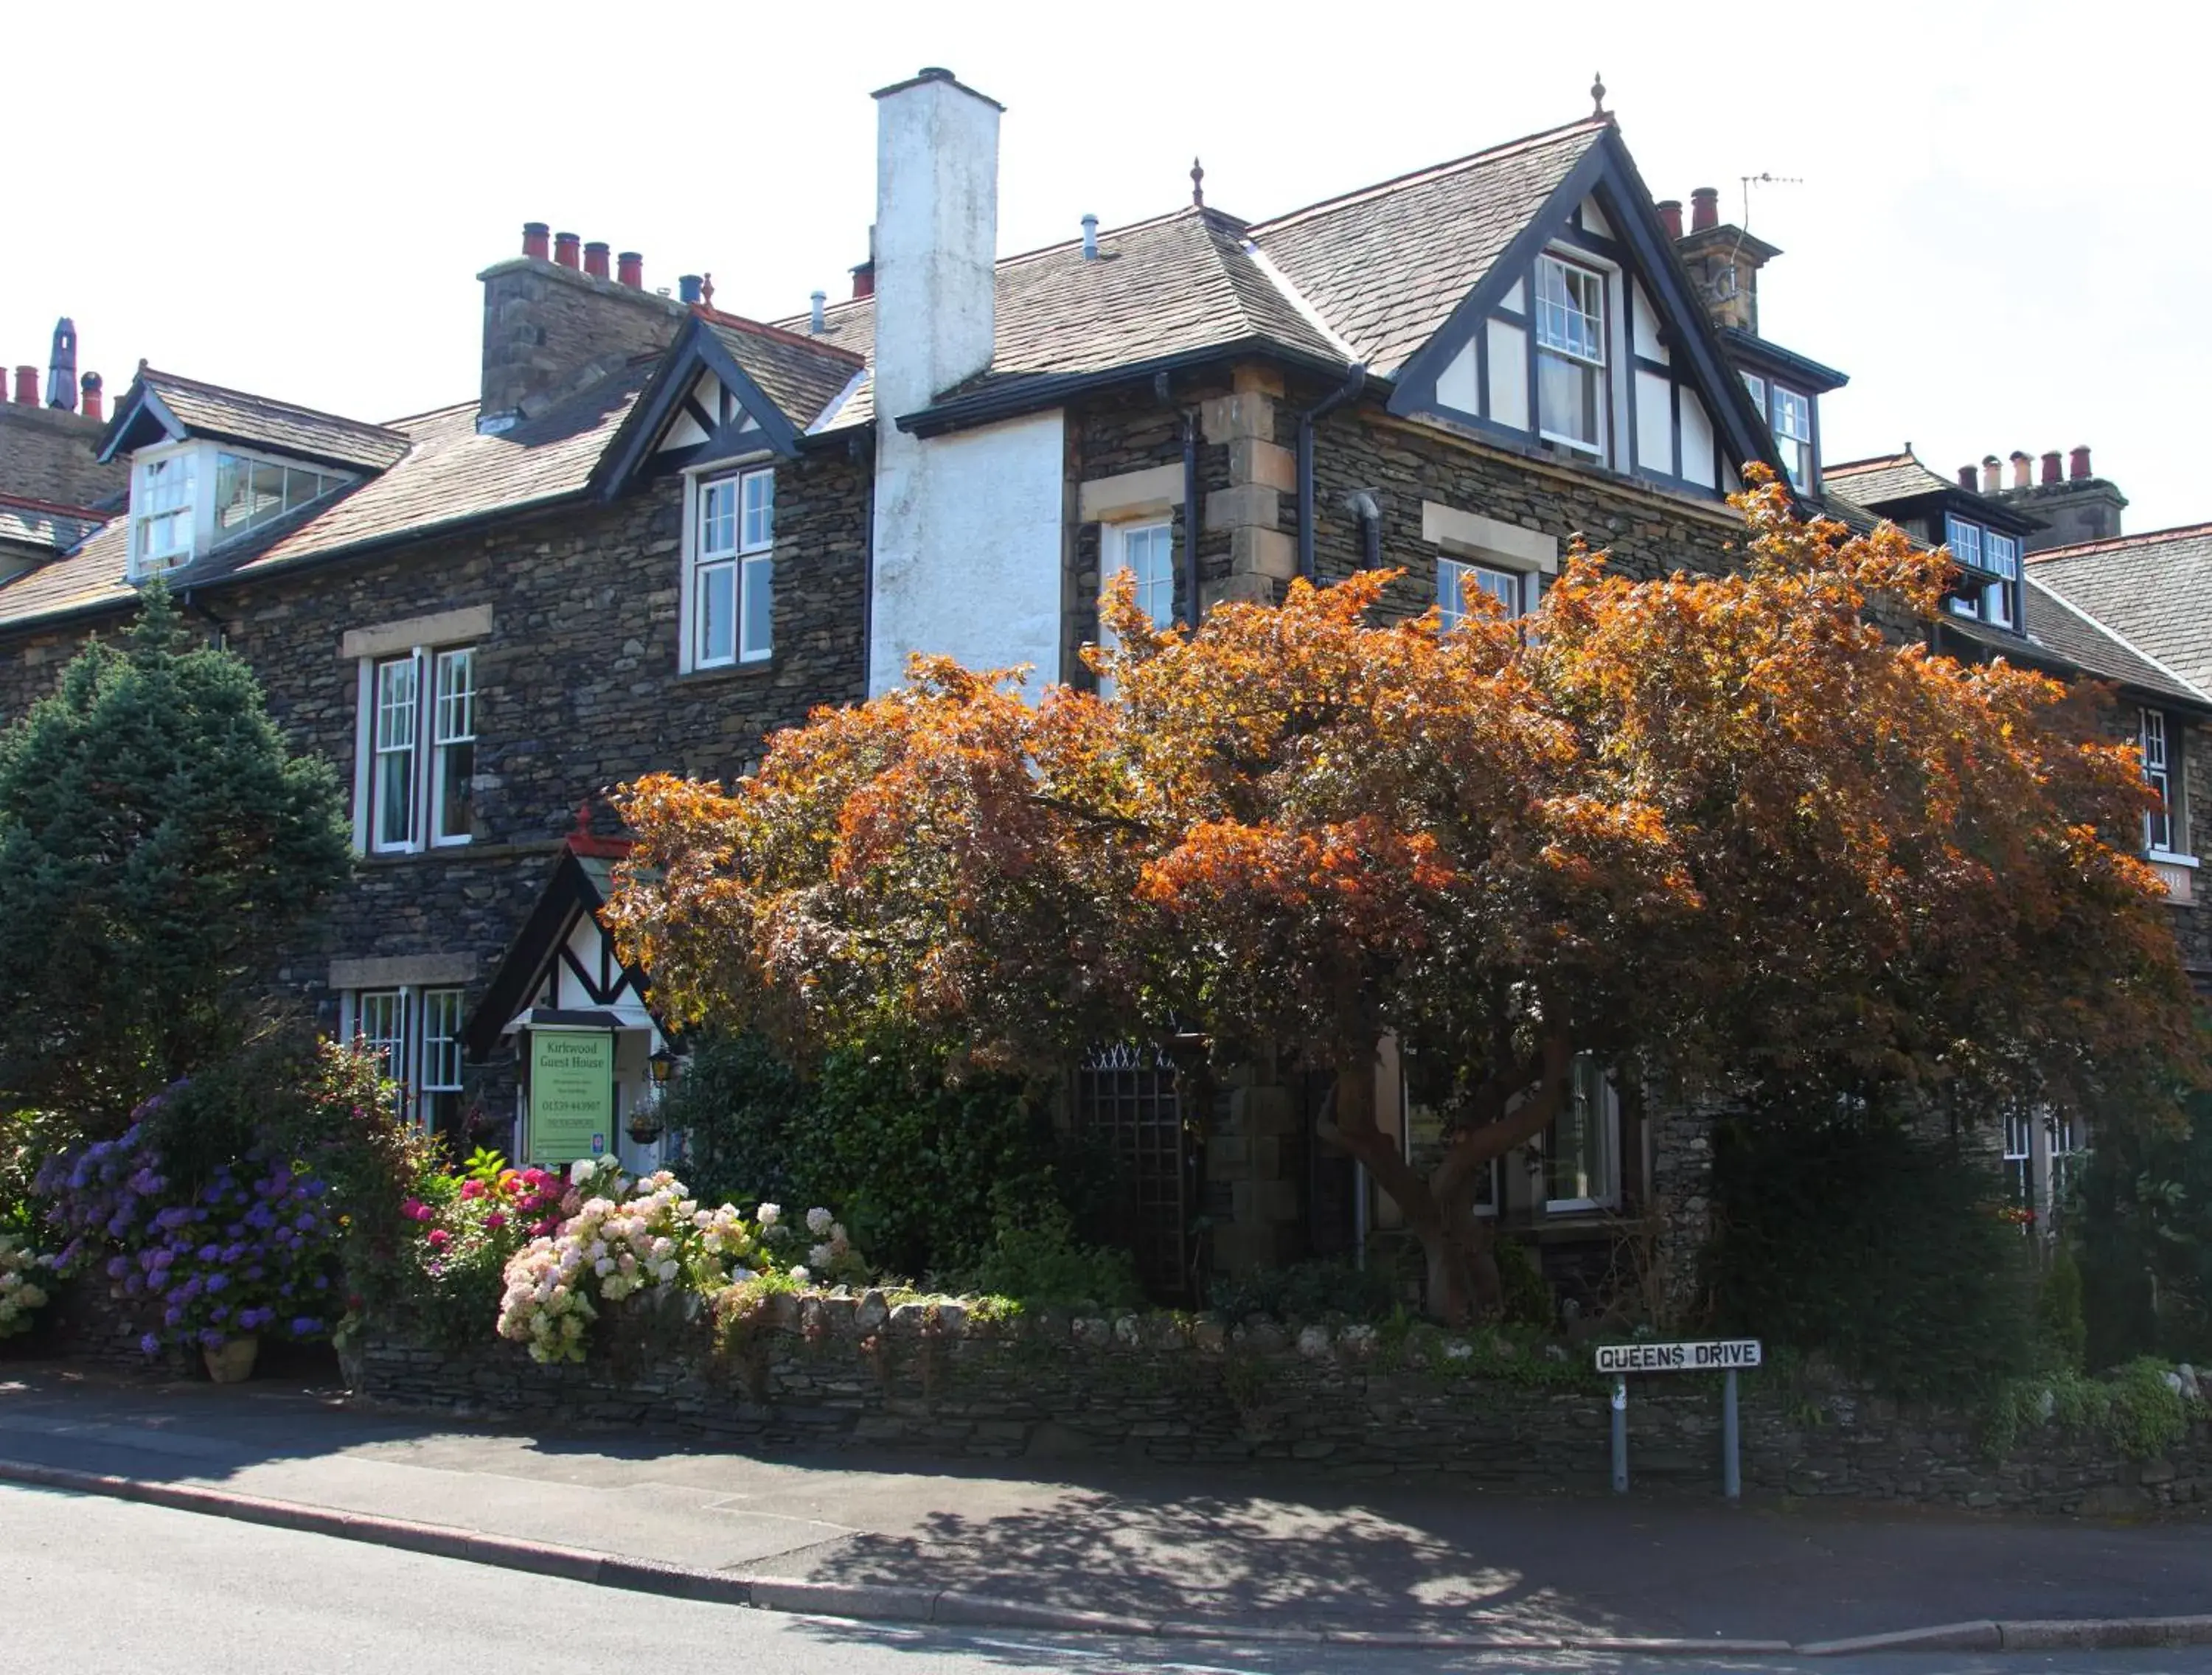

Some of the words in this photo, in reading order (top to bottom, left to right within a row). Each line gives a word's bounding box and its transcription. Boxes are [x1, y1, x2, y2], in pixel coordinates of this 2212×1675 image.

[547, 1041, 597, 1054] Kirkwood
[540, 1055, 569, 1068] Guest
[572, 1056, 604, 1068] House
[1600, 1347, 1685, 1368] QUEENS
[1695, 1344, 1756, 1364] DRIVE
